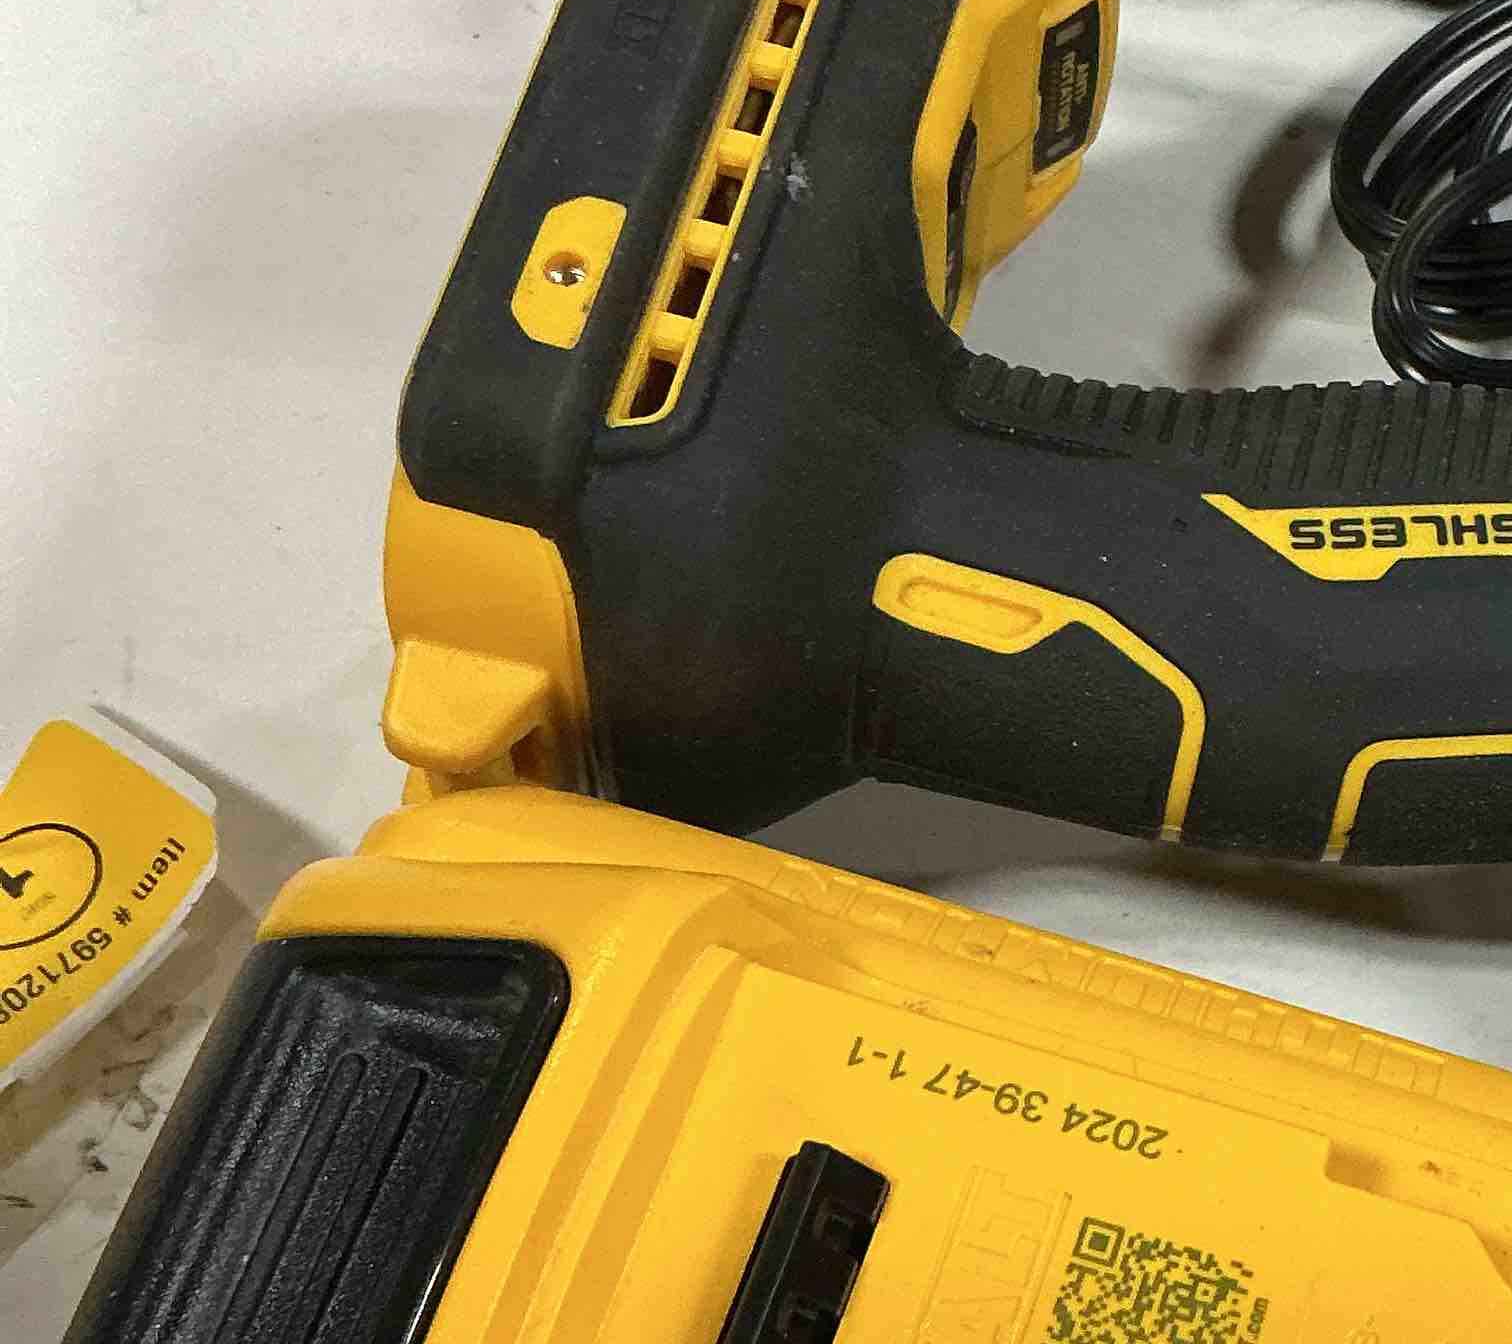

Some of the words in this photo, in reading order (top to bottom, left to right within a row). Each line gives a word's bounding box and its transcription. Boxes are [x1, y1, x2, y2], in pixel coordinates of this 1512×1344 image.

[131, 837, 186, 901] Item
[112, 905, 134, 927] #
[847, 1036, 906, 1081] 1-1
[924, 1063, 1049, 1123] 39-47
[1061, 1102, 1168, 1159] 2024
